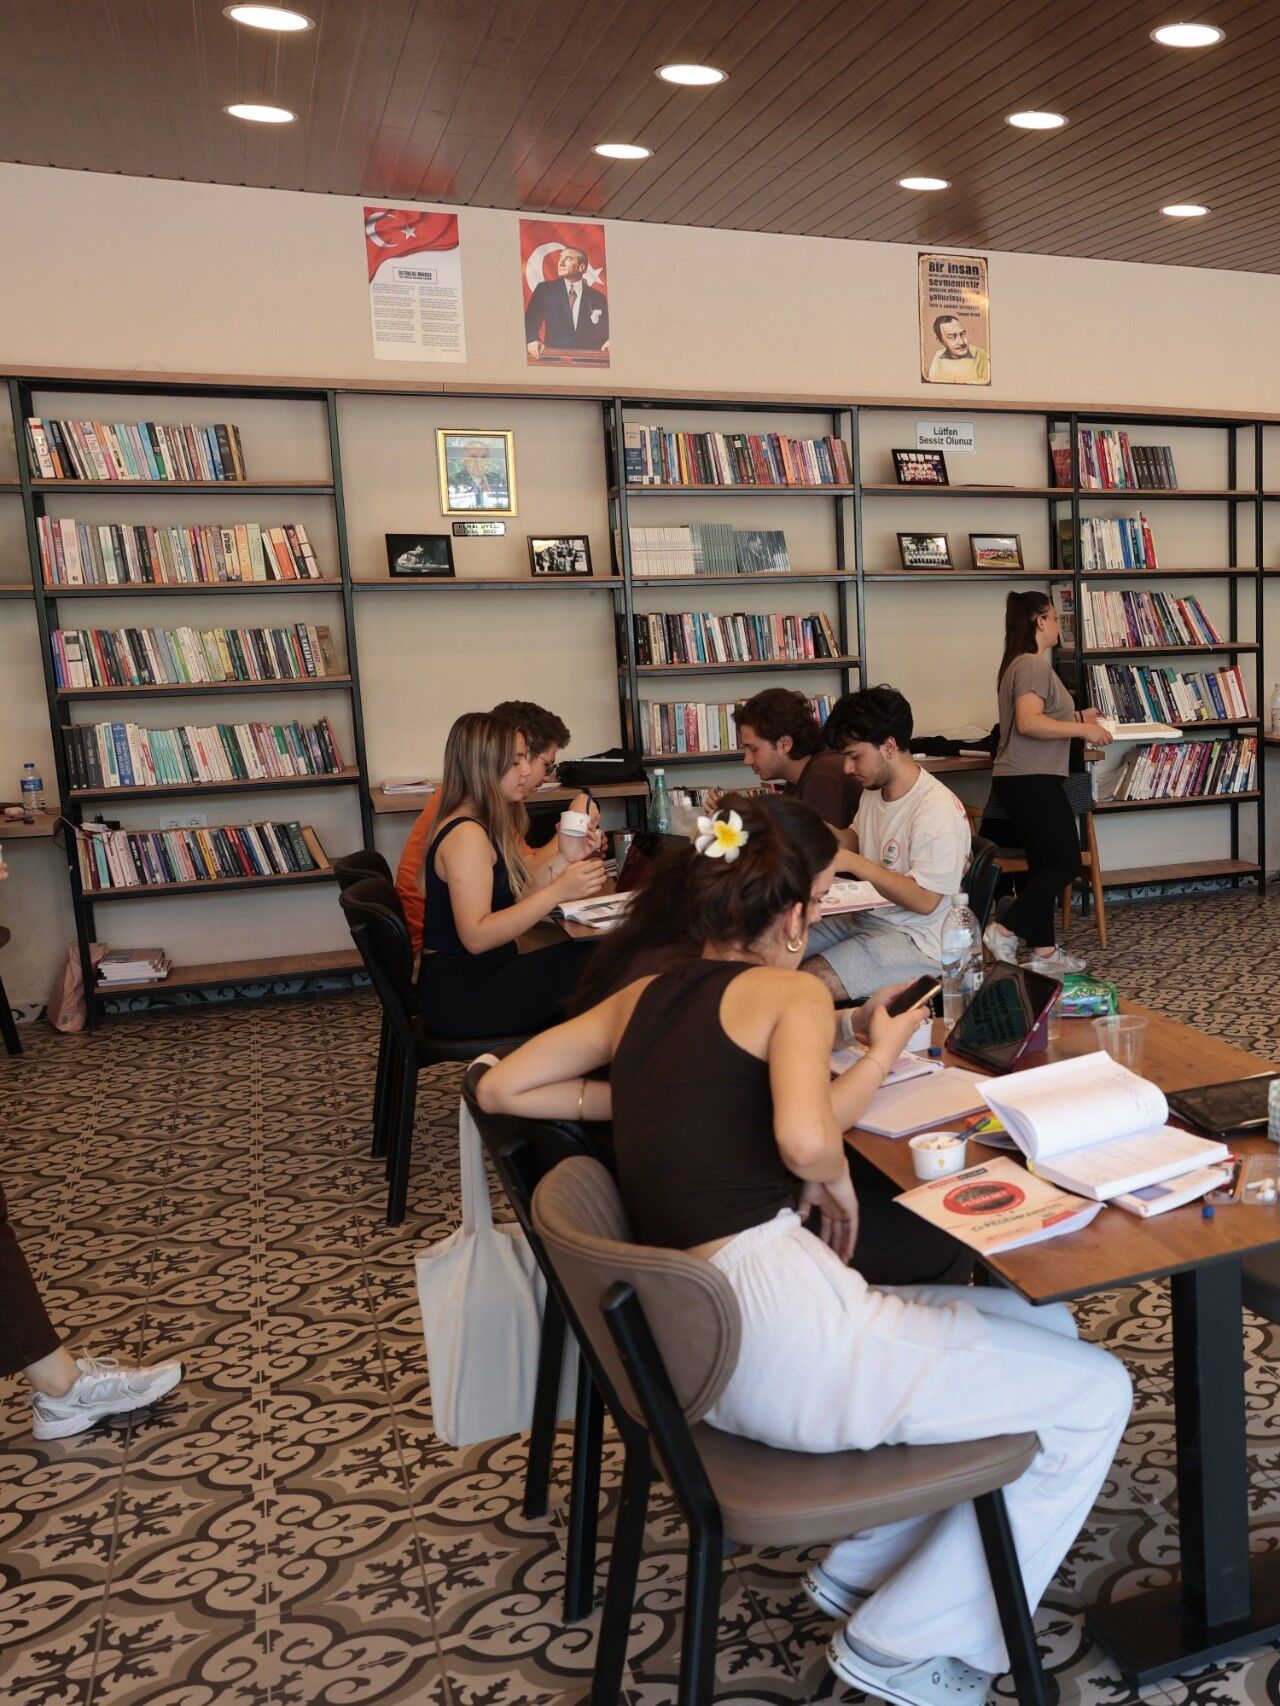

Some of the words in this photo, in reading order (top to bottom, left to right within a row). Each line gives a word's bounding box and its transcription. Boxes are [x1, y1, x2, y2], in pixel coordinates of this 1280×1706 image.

[929, 261, 945, 273] Bir
[947, 262, 980, 276] insan
[933, 427, 958, 436] Lütfen
[919, 436, 944, 445] Sessiz
[945, 436, 973, 446] Olunuz
